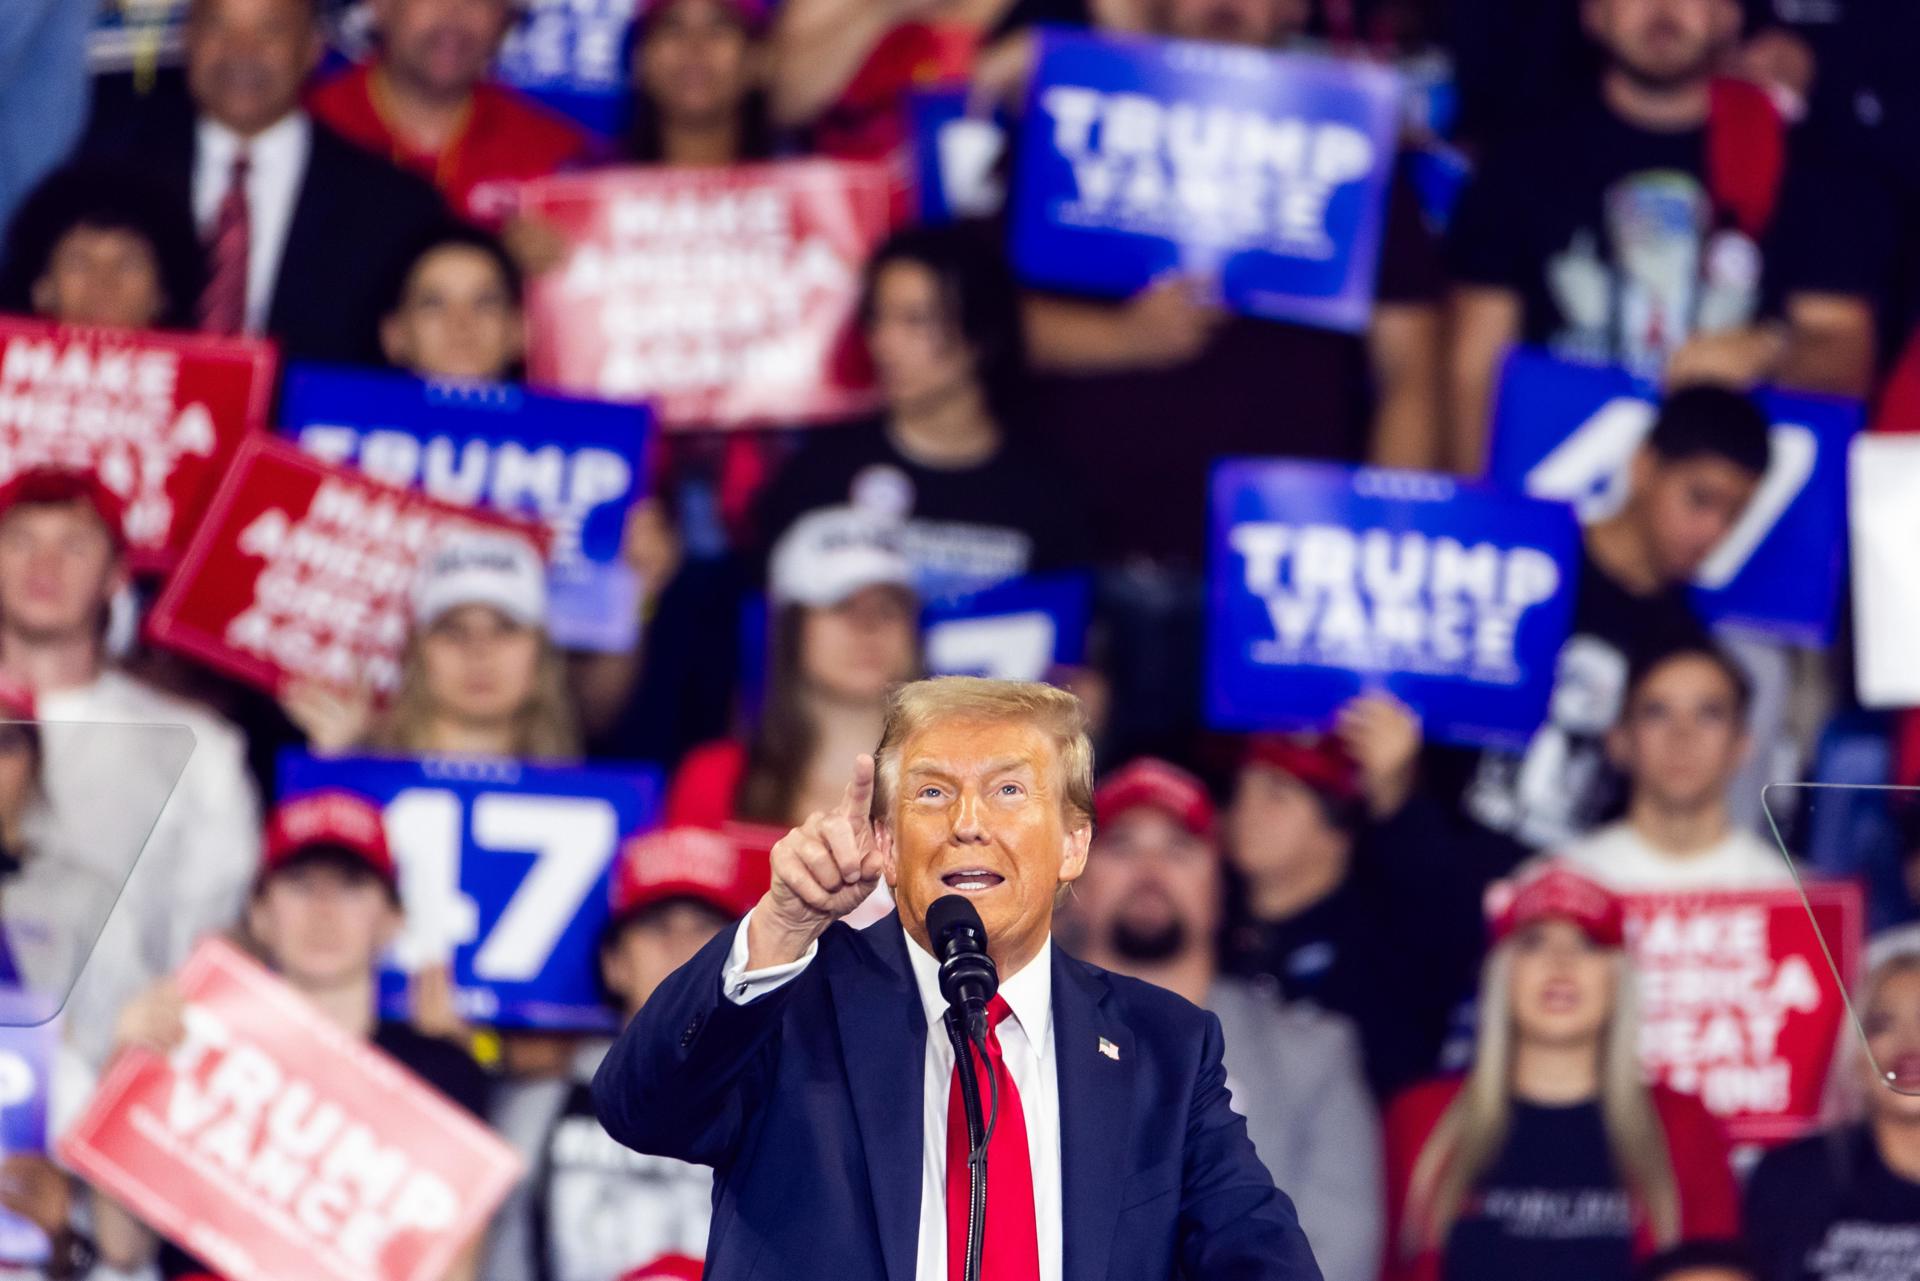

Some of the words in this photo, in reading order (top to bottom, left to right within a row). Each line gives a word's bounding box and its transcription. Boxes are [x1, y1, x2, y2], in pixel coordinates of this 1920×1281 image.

[1042, 85, 1373, 184] TRUMP
[299, 422, 632, 518] TRUMP
[1228, 521, 1560, 606] TRUMP
[1264, 588, 1522, 668] VANCE
[384, 787, 619, 983] 47
[168, 1003, 457, 1231] TRUMP
[168, 1072, 392, 1266] VANCE
